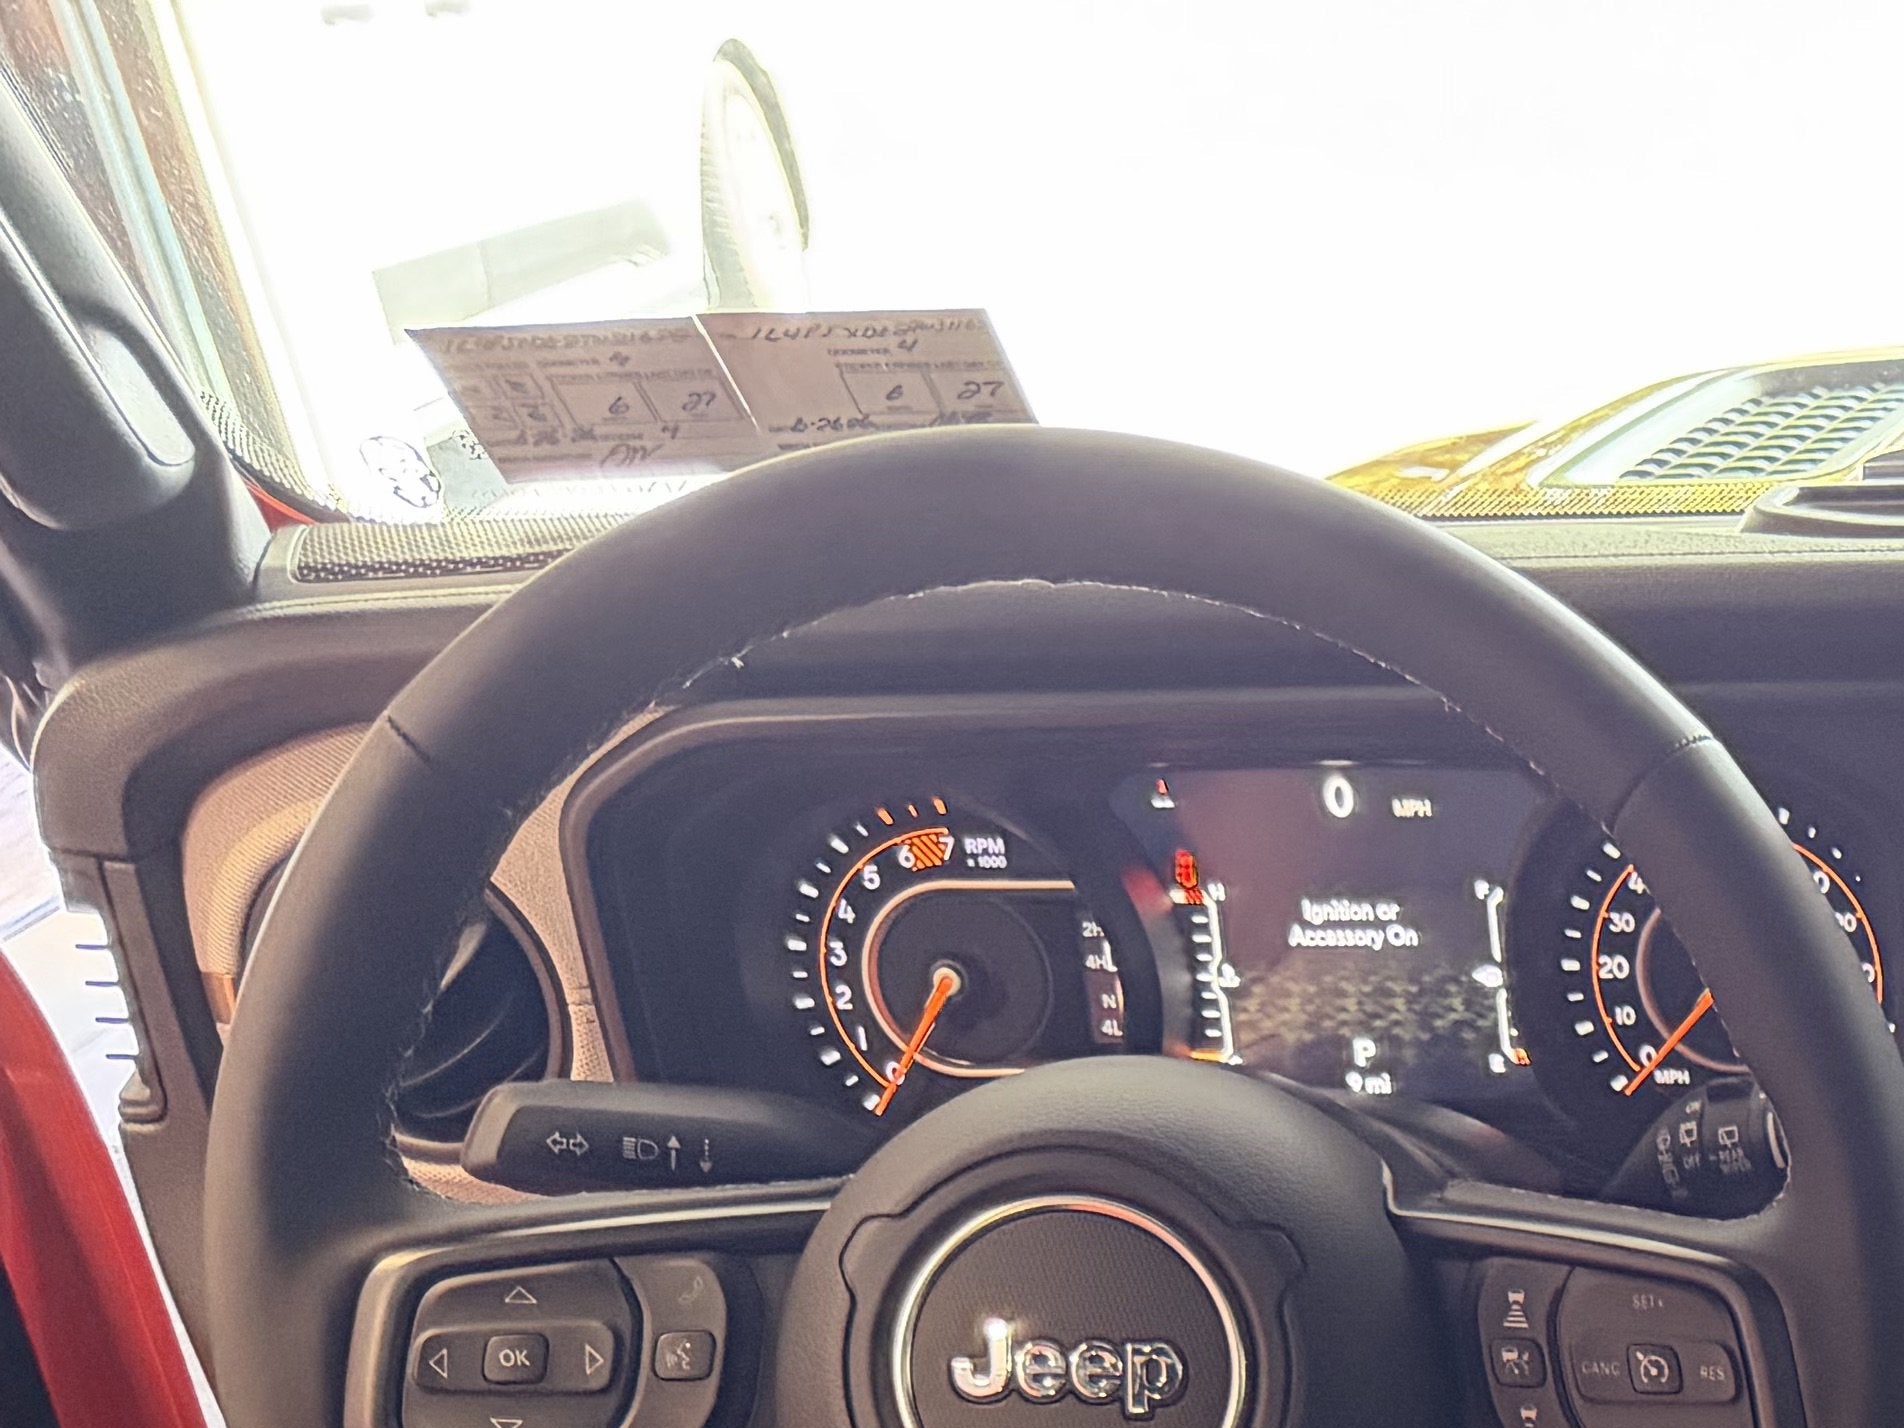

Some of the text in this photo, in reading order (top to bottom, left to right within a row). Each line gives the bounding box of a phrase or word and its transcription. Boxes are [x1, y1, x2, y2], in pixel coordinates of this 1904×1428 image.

[1322, 774, 1433, 818] 0 MPH
[898, 844, 916, 868] 6
[938, 835, 955, 861] 7
[964, 836, 1007, 855] RPM
[977, 855, 1008, 869] 1000
[862, 864, 881, 890] 5
[837, 898, 856, 923] 4
[1301, 897, 1400, 925] Ignition or
[1609, 912, 1636, 933] 30
[1288, 923, 1419, 951] Accessory On
[829, 940, 848, 967] 3
[1598, 954, 1630, 980] 20
[835, 984, 854, 1010] 2
[1101, 993, 1117, 1009] N
[1614, 1004, 1637, 1026] 10
[1353, 1037, 1376, 1067] P
[1364, 1072, 1392, 1094] mi
[1653, 1069, 1691, 1085] MPH
[498, 1348, 531, 1369] OK
[951, 1317, 1185, 1416] Jeep
[1581, 1361, 1621, 1377] CANC
[1699, 1365, 1726, 1381] RES
